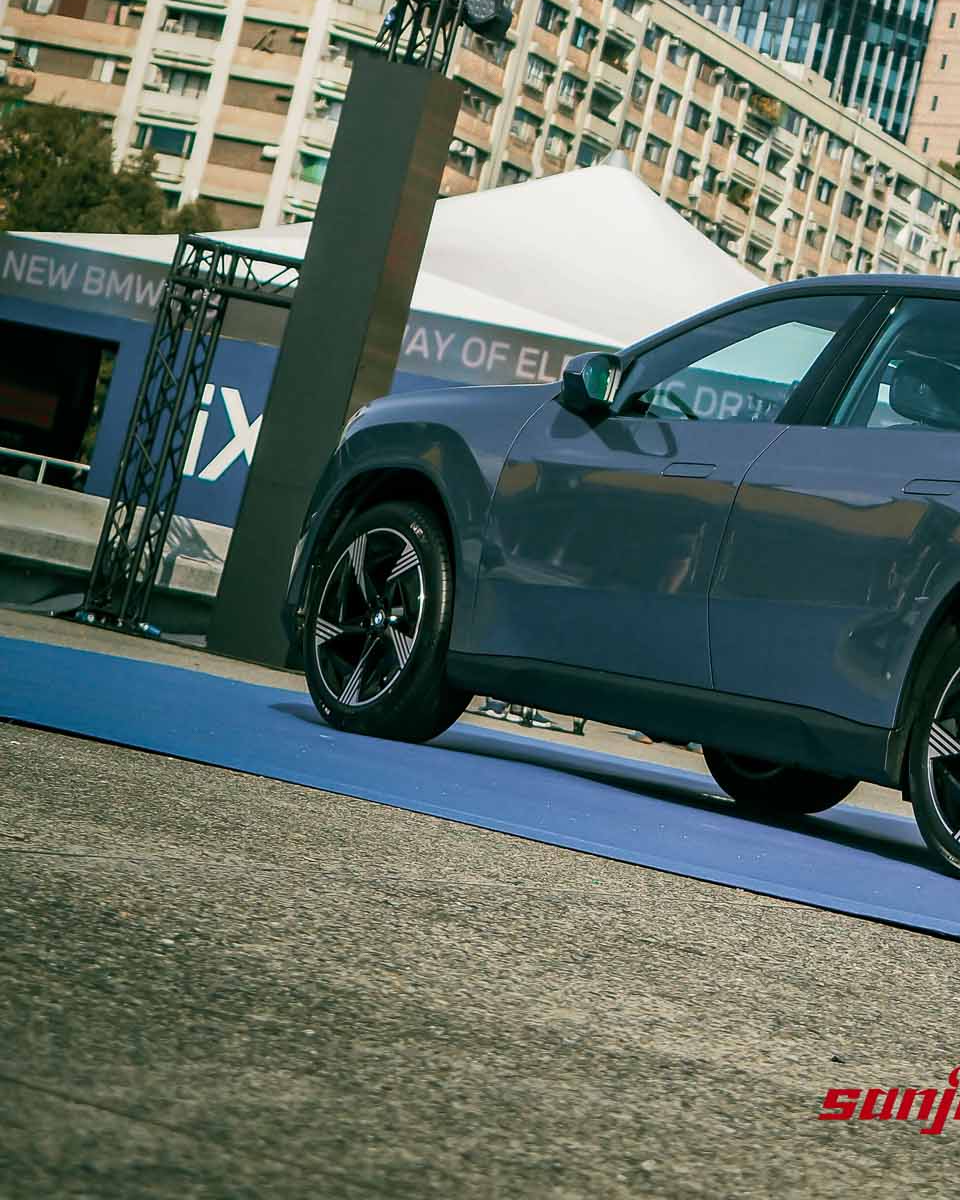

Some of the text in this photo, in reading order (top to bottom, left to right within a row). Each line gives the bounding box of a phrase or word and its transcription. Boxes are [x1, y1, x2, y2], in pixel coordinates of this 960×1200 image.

[1, 250, 77, 290] NEW
[81, 266, 165, 307] BMW
[461, 336, 510, 372] OF
